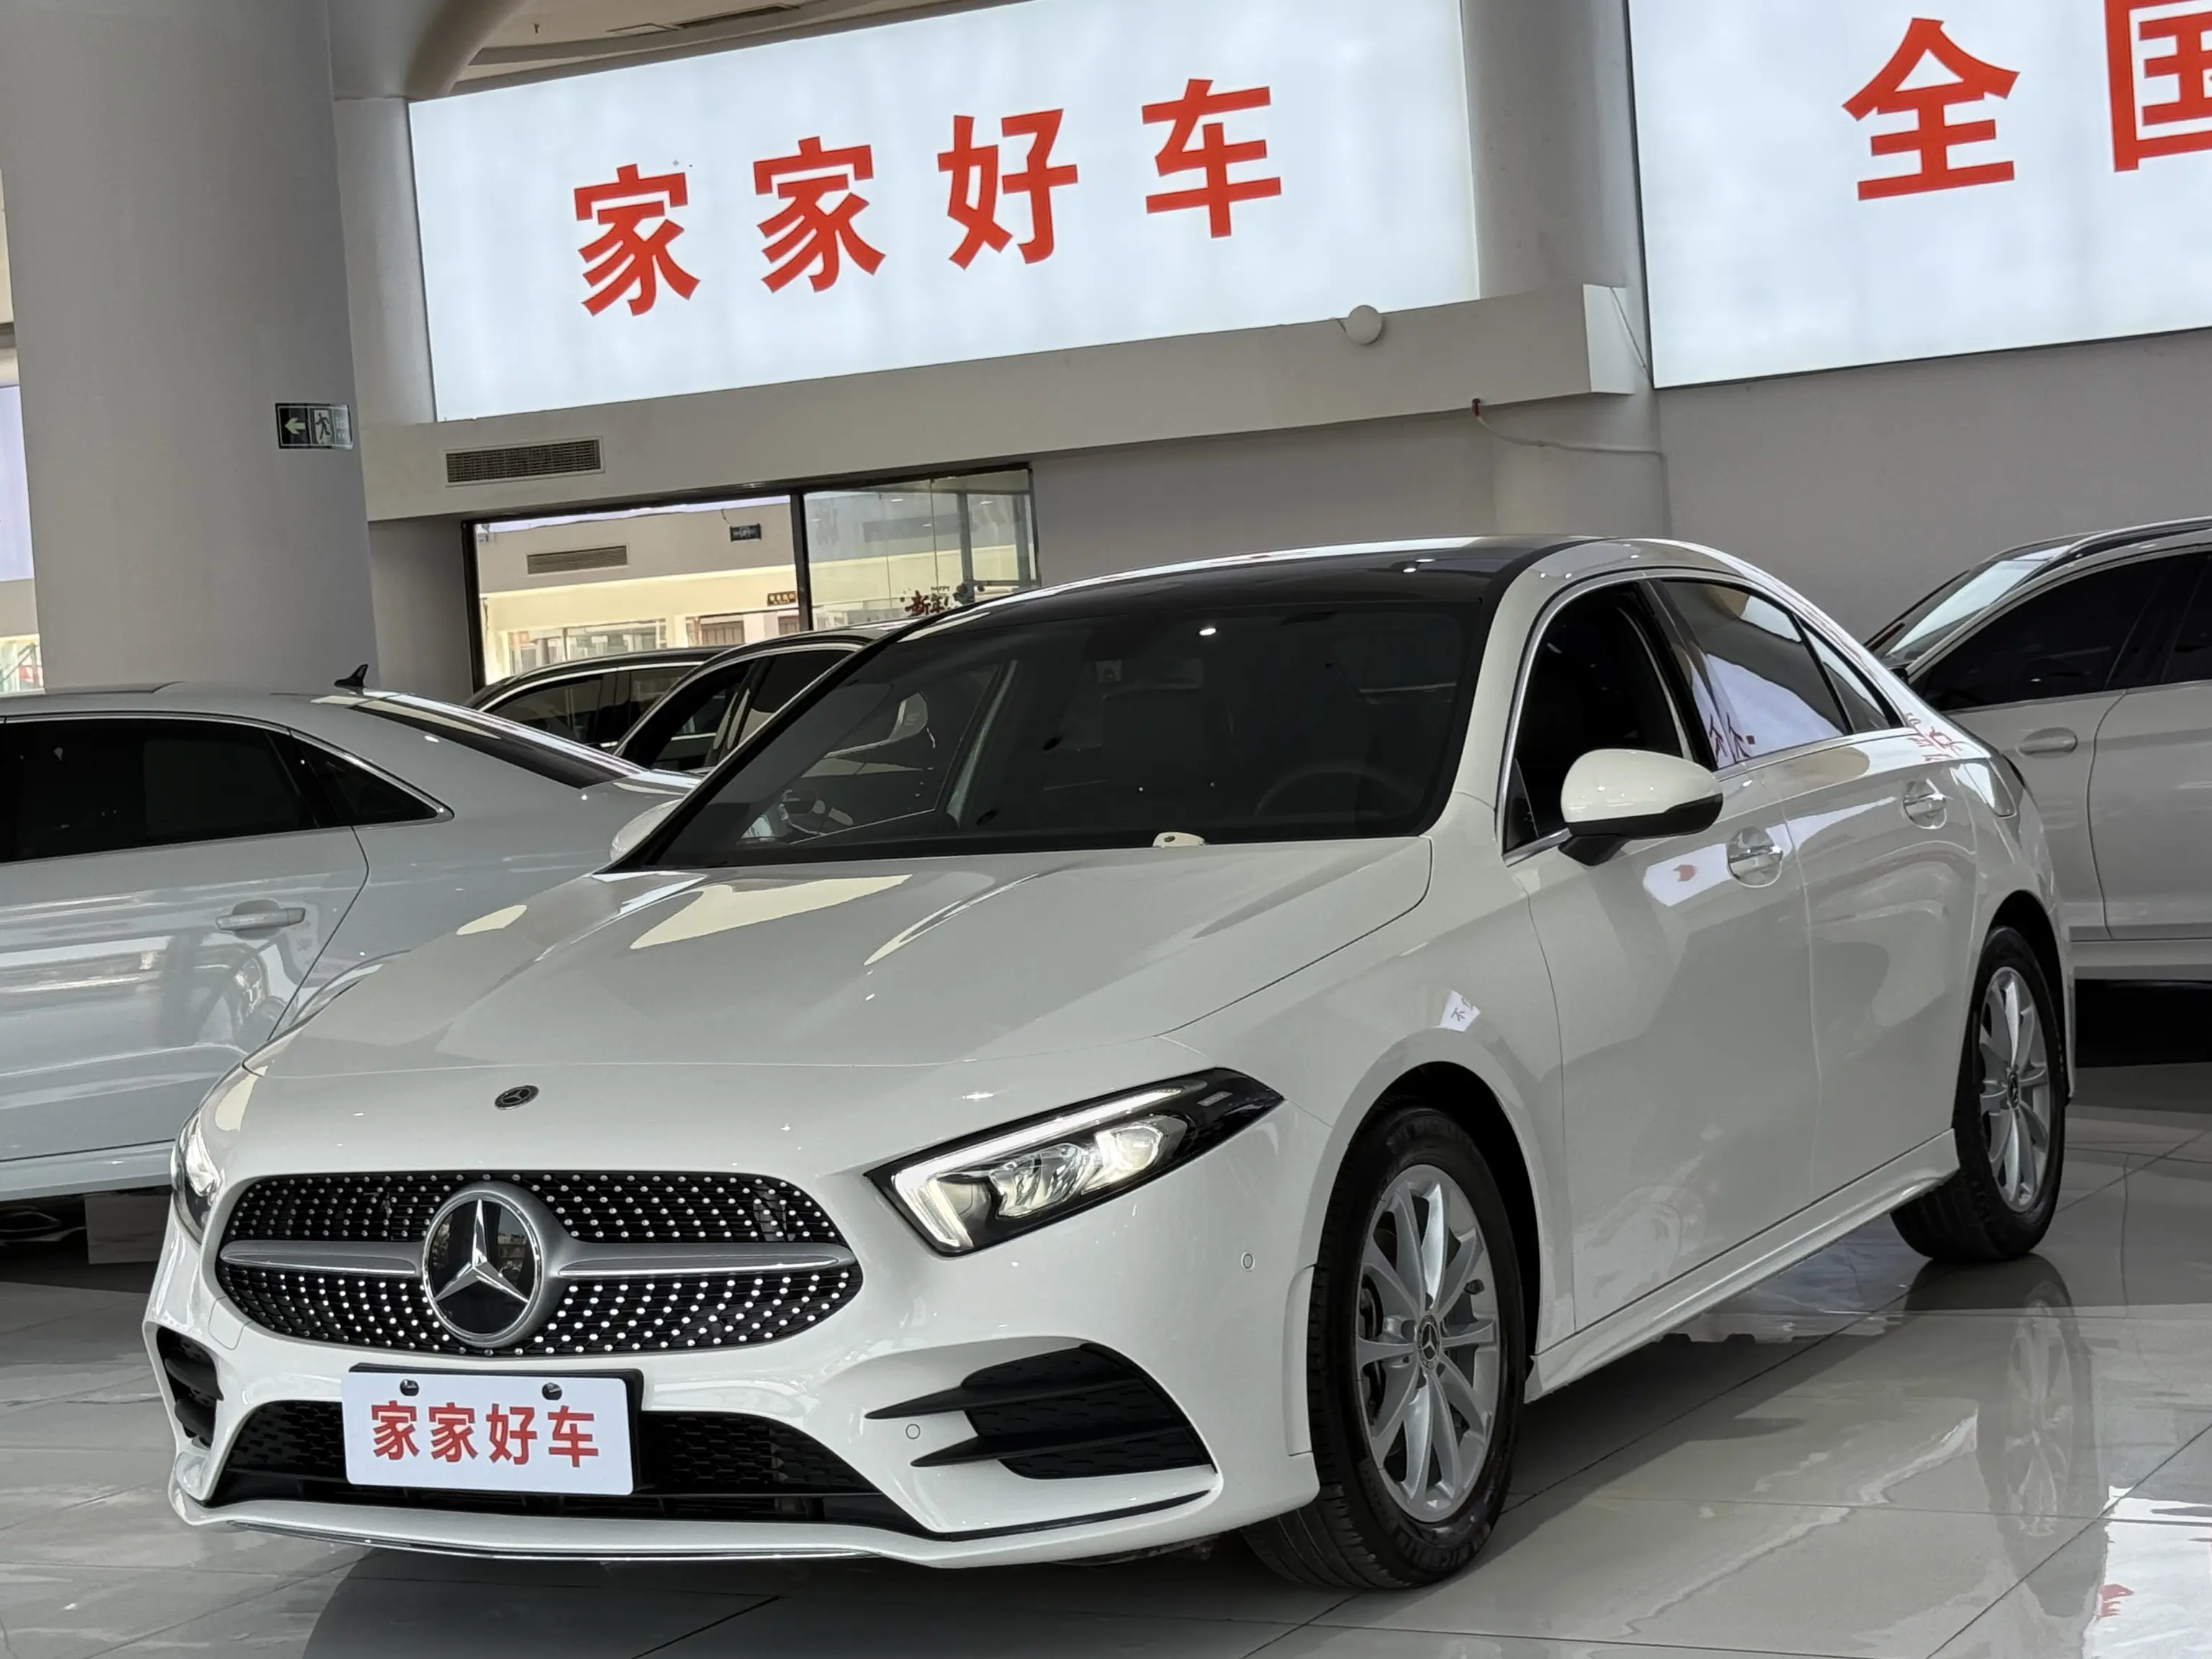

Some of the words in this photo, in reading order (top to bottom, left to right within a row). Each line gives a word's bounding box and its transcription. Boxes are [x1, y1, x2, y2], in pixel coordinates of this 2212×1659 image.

[574, 78, 1281, 316] 家家好车
[371, 1400, 600, 1468] 家家好车
